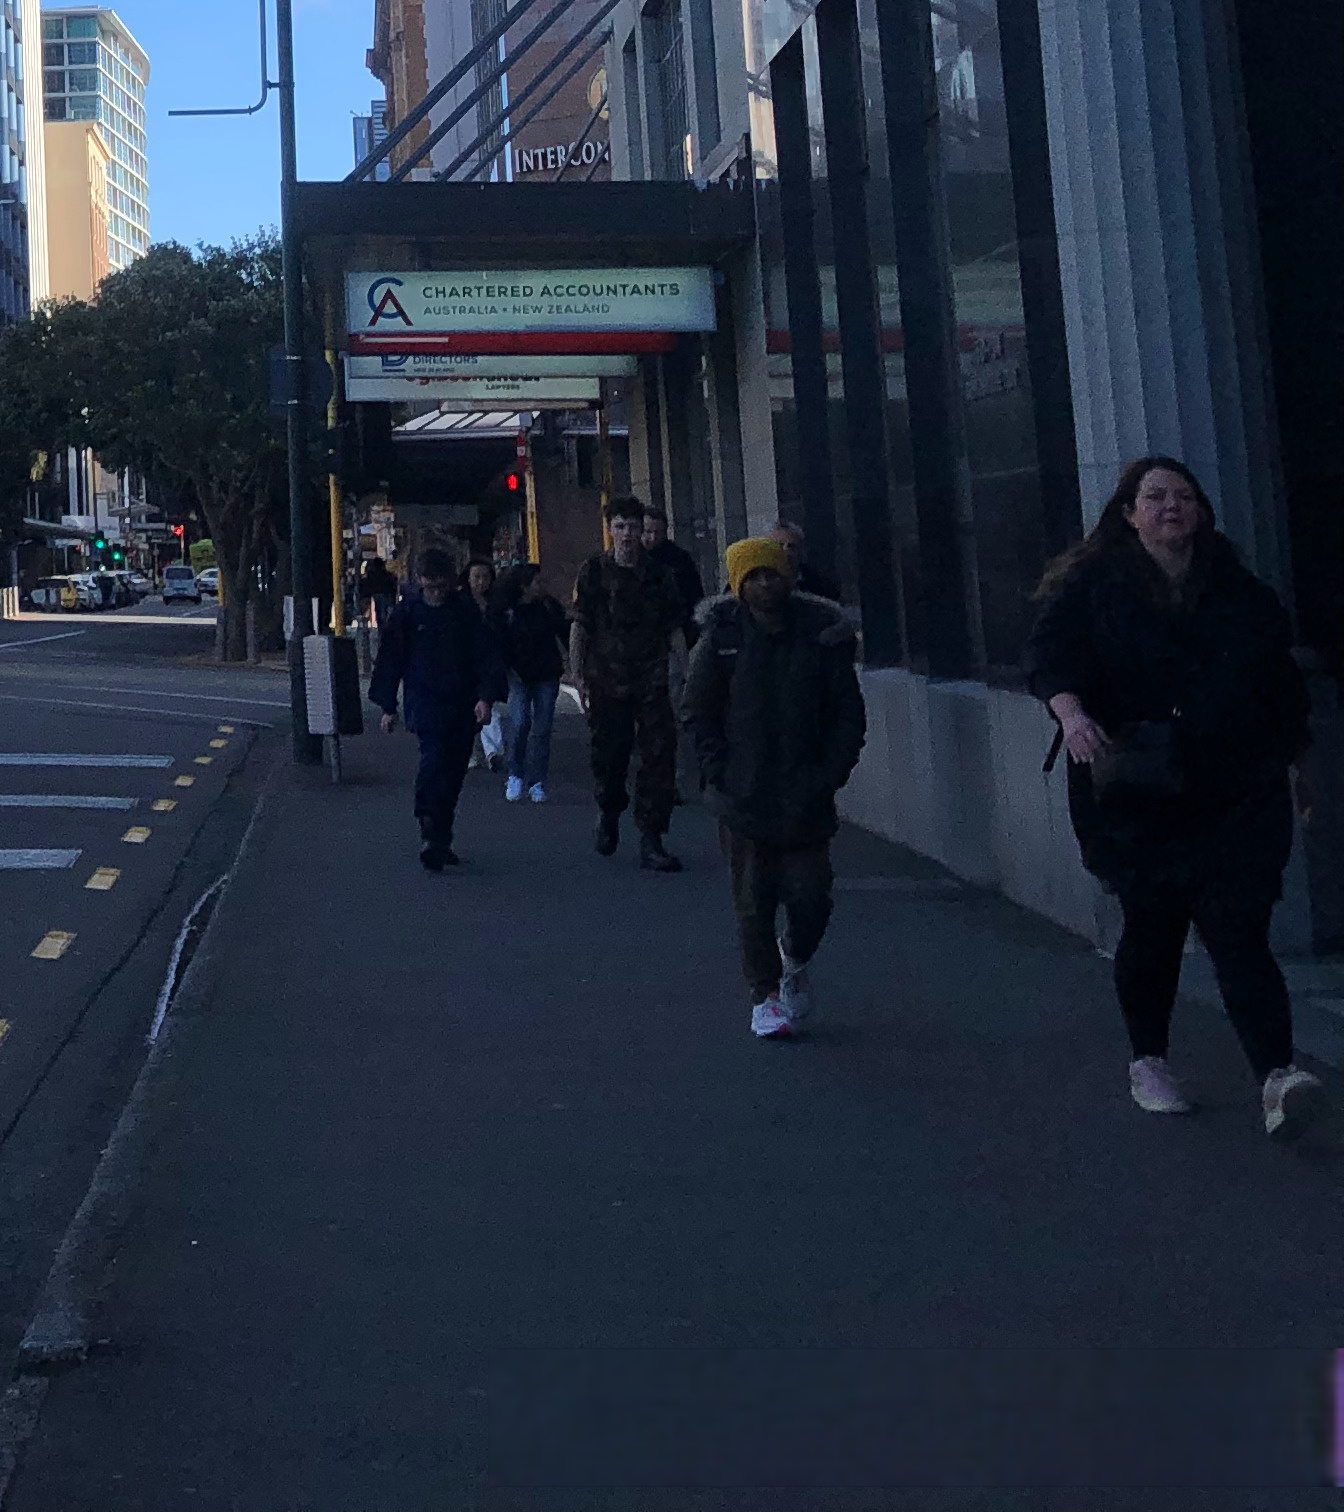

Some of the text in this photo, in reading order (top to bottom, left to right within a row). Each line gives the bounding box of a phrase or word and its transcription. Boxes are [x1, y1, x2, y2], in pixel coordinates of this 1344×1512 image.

[422, 282, 681, 299] CHARTERED ACCOUNTANTS
[423, 303, 611, 316] AUSTRALIA NEW ZEALAND
[413, 355, 479, 365] DIRECTORS
